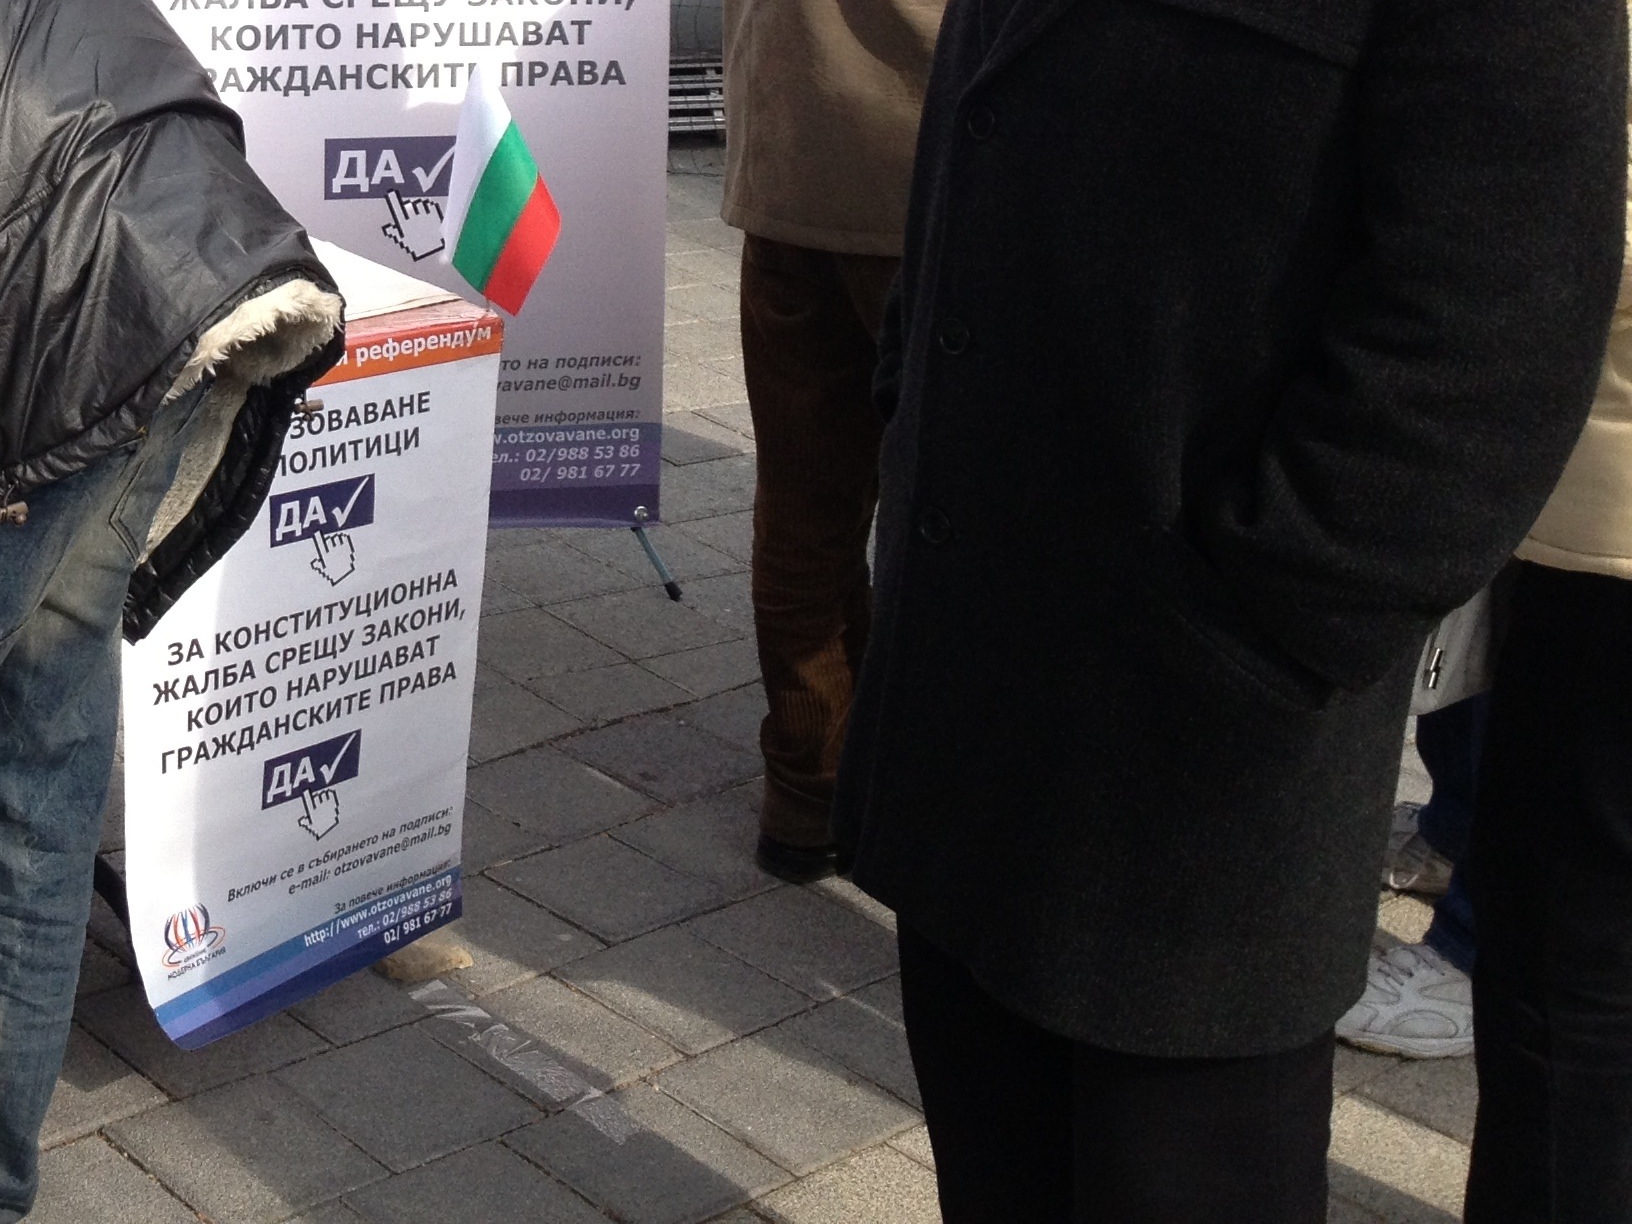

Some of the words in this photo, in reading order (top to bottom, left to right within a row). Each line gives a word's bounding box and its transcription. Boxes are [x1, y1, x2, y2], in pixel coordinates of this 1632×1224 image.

[211, 23, 341, 51] КОИТО
[356, 20, 593, 49] НАРУШАВАТ
[501, 60, 627, 87] ПРАВА
[332, 148, 405, 193] ДА
[355, 326, 492, 367] референдум
[500, 360, 521, 371] то
[526, 358, 549, 370] на
[555, 355, 641, 370] подписи:
[497, 373, 641, 392] avane@mail.bg
[289, 391, 430, 440] ЗОВАВАНЕ
[493, 427, 640, 445] .otzovavane.org
[494, 413, 529, 425] вече
[534, 409, 641, 425] информация:
[491, 452, 520, 464] ел.:
[525, 446, 589, 463] 02/988
[594, 445, 614, 459] 53
[619, 444, 640, 458] 86
[520, 467, 551, 482] 02/
[557, 465, 587, 480] 981
[594, 464, 615, 478] 67
[620, 463, 641, 477] 77
[276, 495, 328, 540] ДА
[167, 638, 204, 666] ЗА
[215, 569, 458, 655] КОНСТИТУЦИОННА
[152, 659, 256, 705] ЖАЛБА
[265, 629, 355, 674] СРЕЩУ
[362, 597, 465, 646] ЗАКОНИ,
[187, 686, 277, 732] КОИТО
[286, 635, 440, 701] НАРУШАВАТ
[161, 688, 371, 774] ГРАЖДАНСКИТЕ
[379, 661, 457, 704] ПРАВА
[267, 756, 315, 804] ДА
[227, 873, 277, 902] Включи
[280, 867, 294, 881] се
[297, 863, 305, 873] в
[308, 836, 377, 870] събирането
[381, 829, 396, 843] на
[399, 806, 454, 834] подписи:
[288, 870, 332, 895] e-mail:
[333, 822, 452, 877] otzovavane@mail.bg
[334, 902, 346, 914] За
[348, 887, 384, 907] повече
[386, 859, 452, 893] информация:
[303, 873, 453, 948] http://www.otzovavane.org
[357, 921, 381, 940] тел.:
[382, 900, 421, 927] 02/988
[422, 895, 438, 910] 53
[438, 888, 452, 904] 86
[383, 928, 401, 946] 02/
[402, 917, 421, 935] 981
[423, 909, 438, 924] 67
[439, 902, 453, 917] 77
